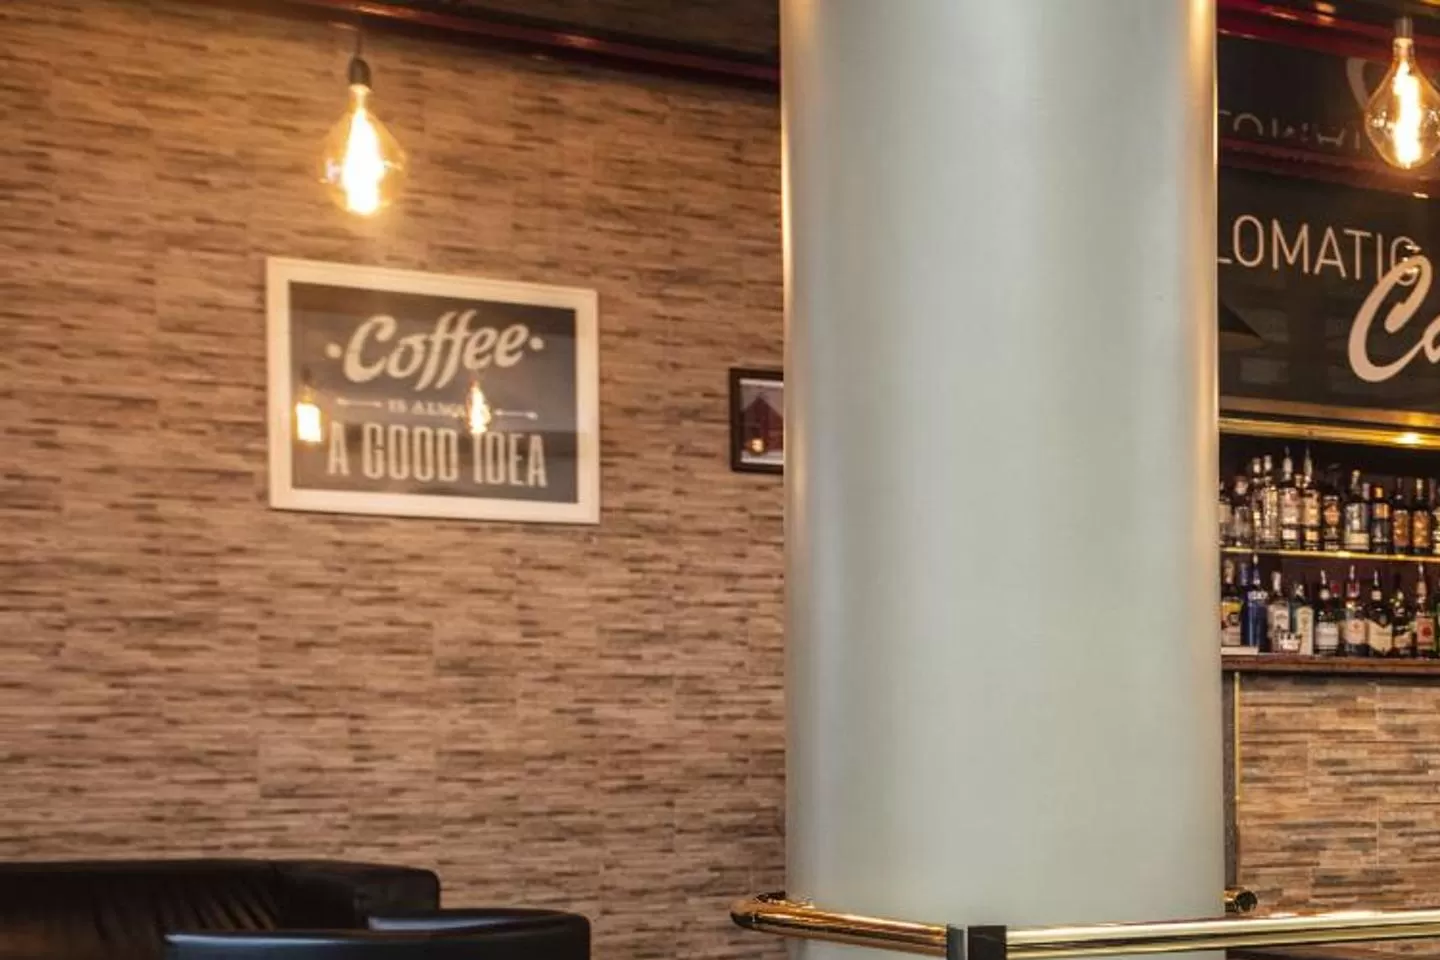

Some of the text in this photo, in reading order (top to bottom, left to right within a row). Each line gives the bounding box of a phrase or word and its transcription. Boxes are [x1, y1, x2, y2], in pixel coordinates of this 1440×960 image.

[342, 309, 529, 391] Coffee
[328, 420, 549, 488] A GOOD IDEA
